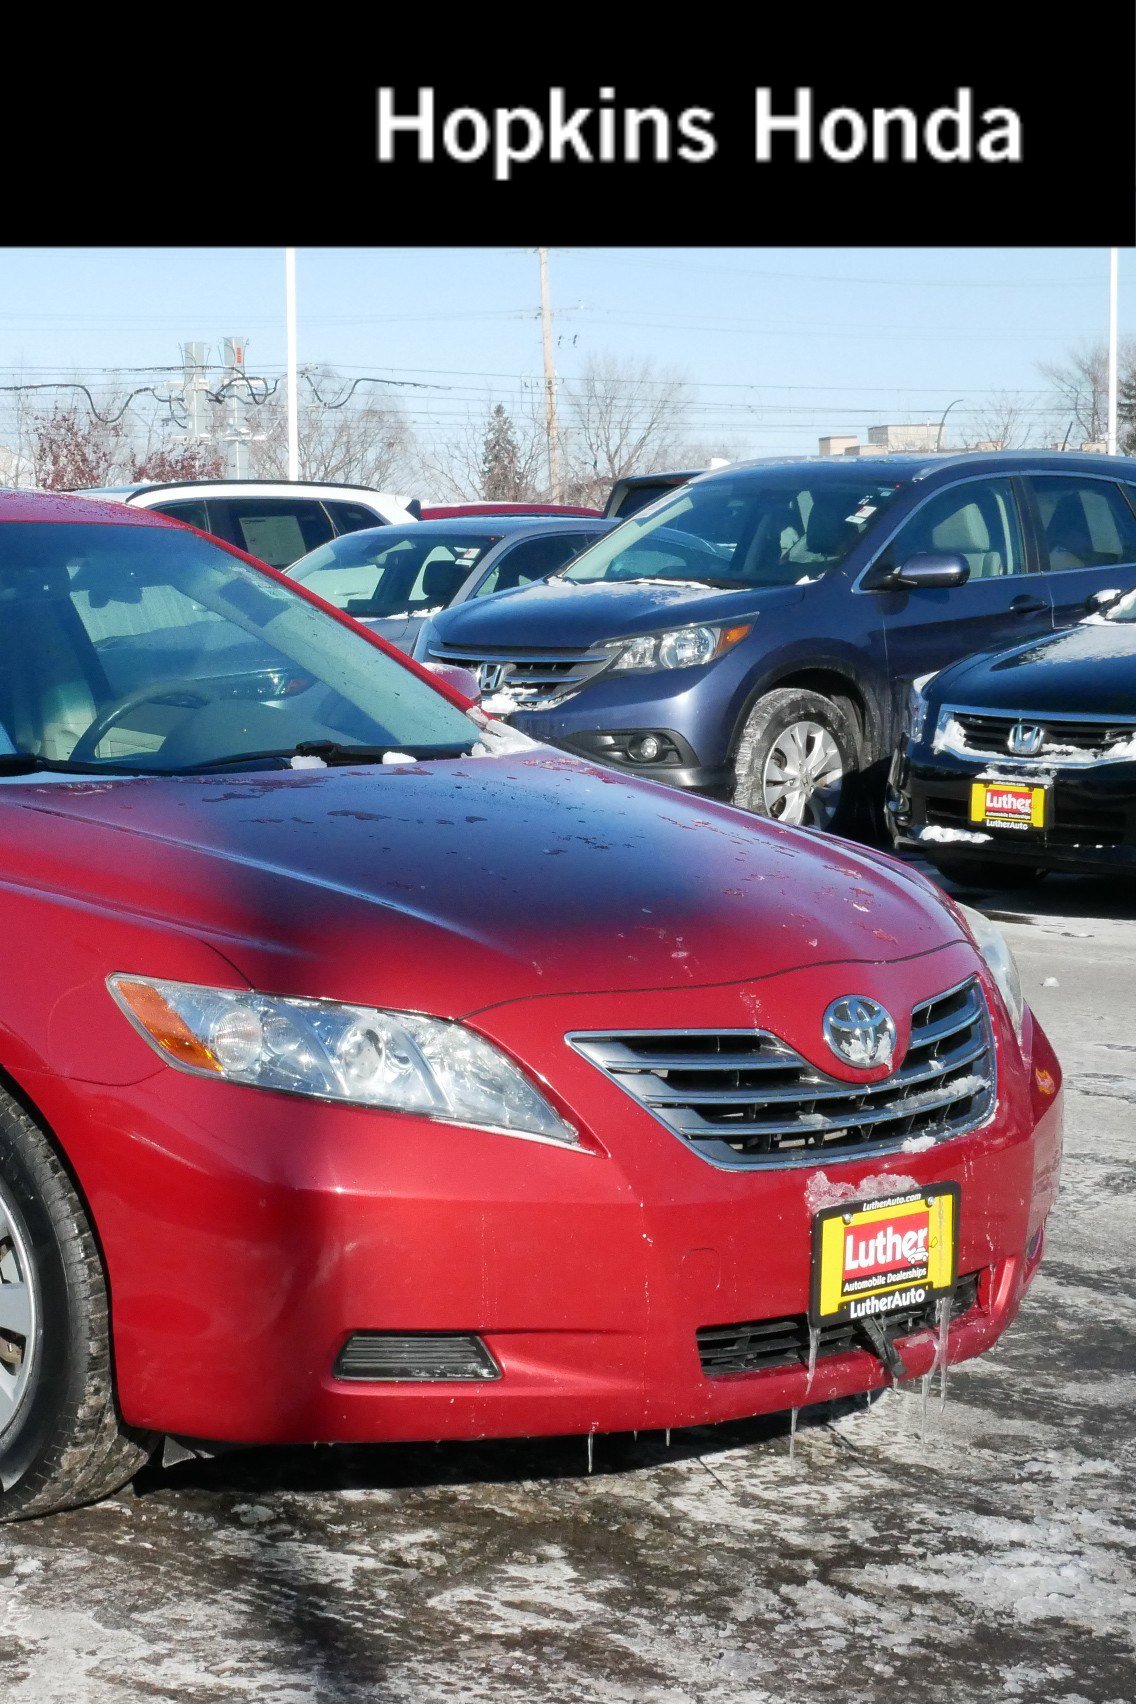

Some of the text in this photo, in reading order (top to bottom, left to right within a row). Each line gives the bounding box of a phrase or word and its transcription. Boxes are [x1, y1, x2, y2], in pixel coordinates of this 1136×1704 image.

[986, 792, 1031, 809] Luther
[986, 819, 1028, 830] LutherAuto
[862, 1193, 922, 1211] LutherAuto.com
[844, 1226, 929, 1271] Luther
[843, 1267, 927, 1293] Automobile Dealerships
[850, 1288, 926, 1319] LutherAuto
